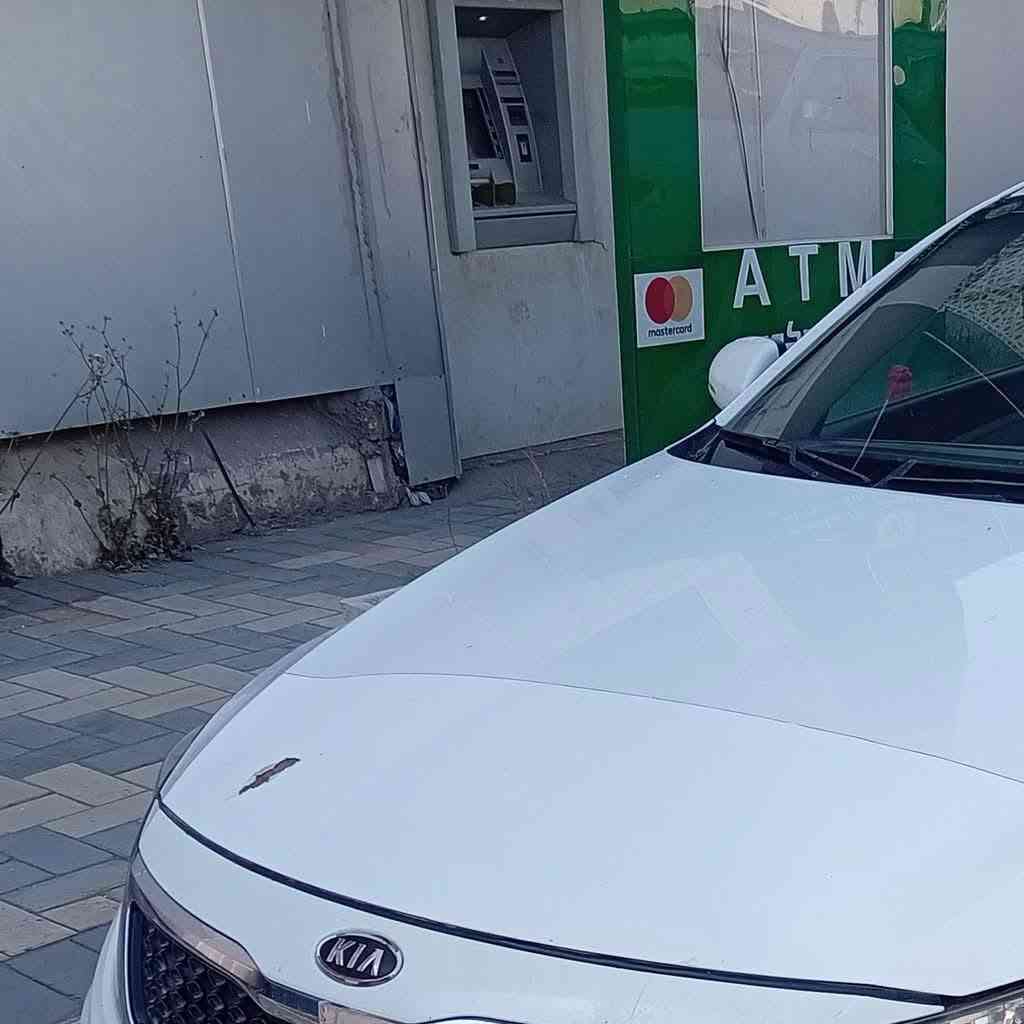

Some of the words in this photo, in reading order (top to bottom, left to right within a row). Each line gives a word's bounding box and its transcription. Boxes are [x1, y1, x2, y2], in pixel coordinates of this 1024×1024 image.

[732, 240, 873, 309] ATM
[647, 323, 693, 337] mastercard
[325, 937, 385, 977] KIA
